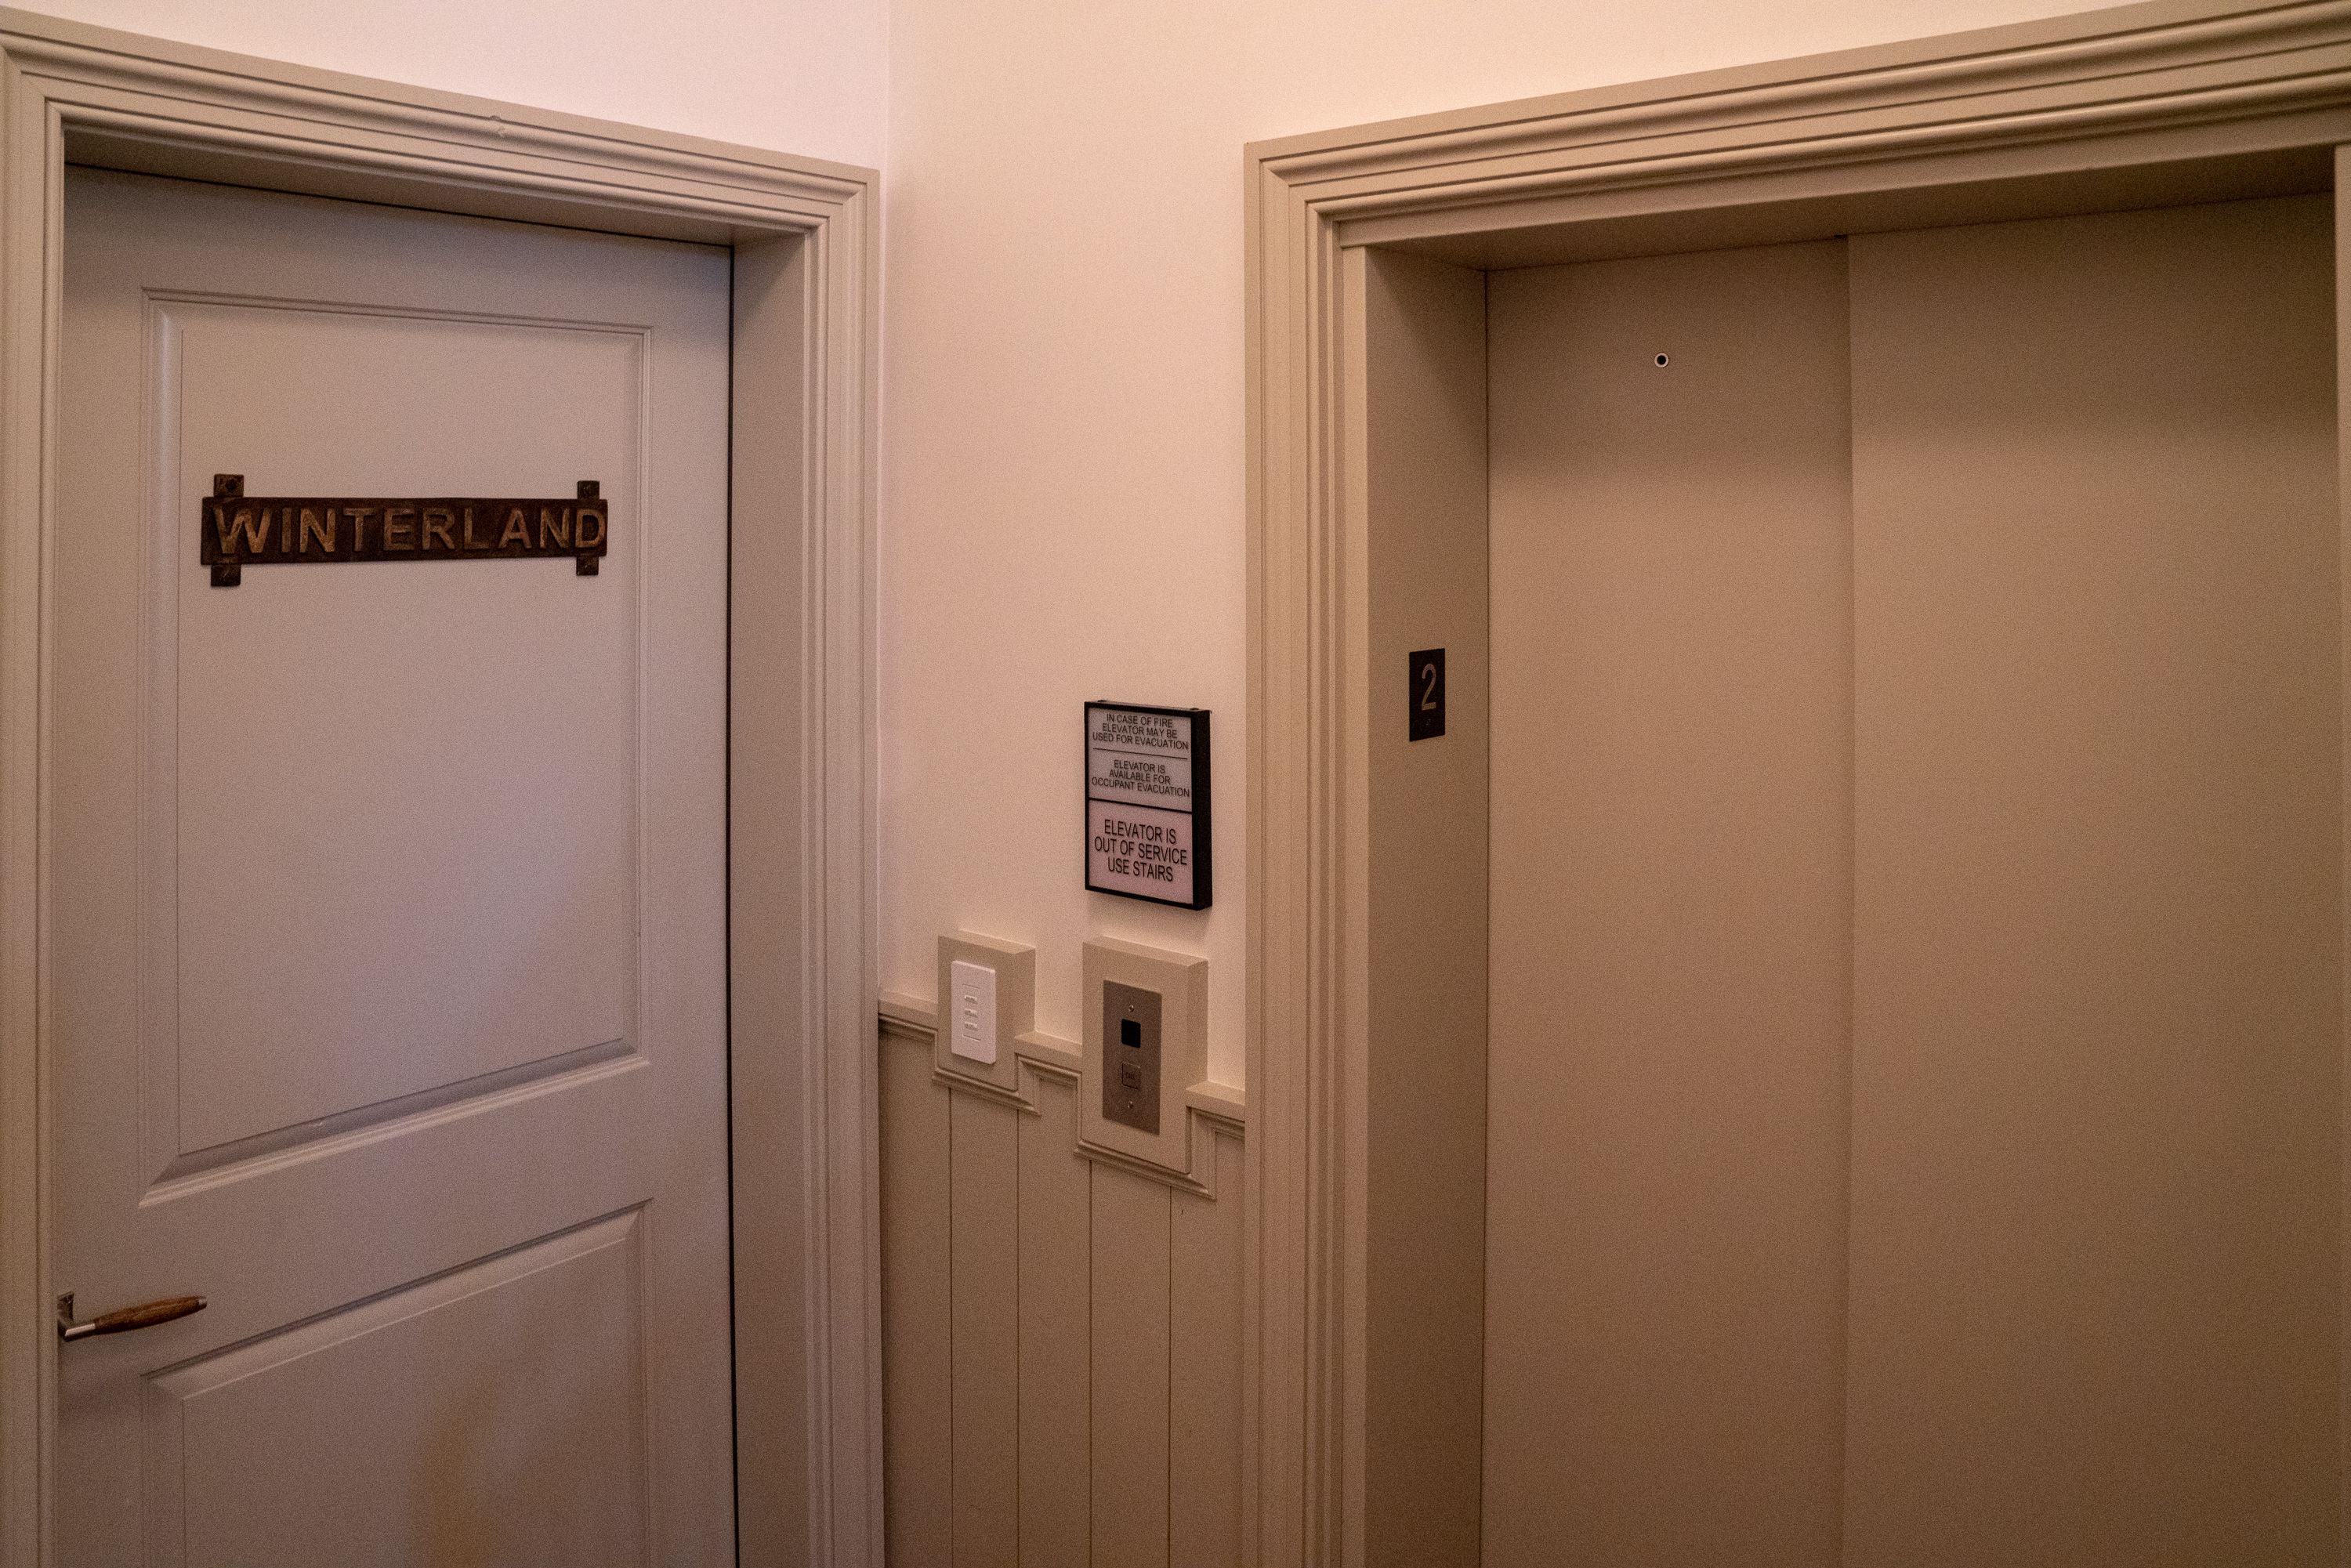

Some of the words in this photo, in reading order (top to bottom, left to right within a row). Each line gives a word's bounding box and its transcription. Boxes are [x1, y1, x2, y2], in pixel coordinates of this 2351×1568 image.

[213, 507, 607, 554] WINTERLAND
[1422, 664, 1436, 711] 2
[1103, 722, 1144, 735] ELEVATOR
[1147, 729, 1165, 737] MAY
[1107, 714, 1114, 722] IN
[1117, 715, 1138, 724] CASE
[1141, 716, 1151, 725] OF
[1154, 719, 1172, 728] FIRE
[1092, 732, 1114, 741] USED
[1116, 734, 1132, 744] FOR
[1136, 737, 1188, 750] EVACUATION
[1114, 759, 1155, 772] ELEVATOR
[1157, 765, 1165, 773] IS
[1092, 777, 1135, 791] OCCUPANT
[1137, 783, 1190, 797] EVACUATION
[1109, 770, 1150, 782] AVAILABLE
[1154, 775, 1170, 784] FOR
[1104, 819, 1162, 842] ELEVATOR
[1166, 828, 1176, 844] IS
[1095, 836, 1117, 853] OUT
[1120, 840, 1134, 856] OF
[1138, 843, 1187, 865] SERVICE
[1108, 857, 1129, 875] USE
[1133, 861, 1173, 882] STAIRS
